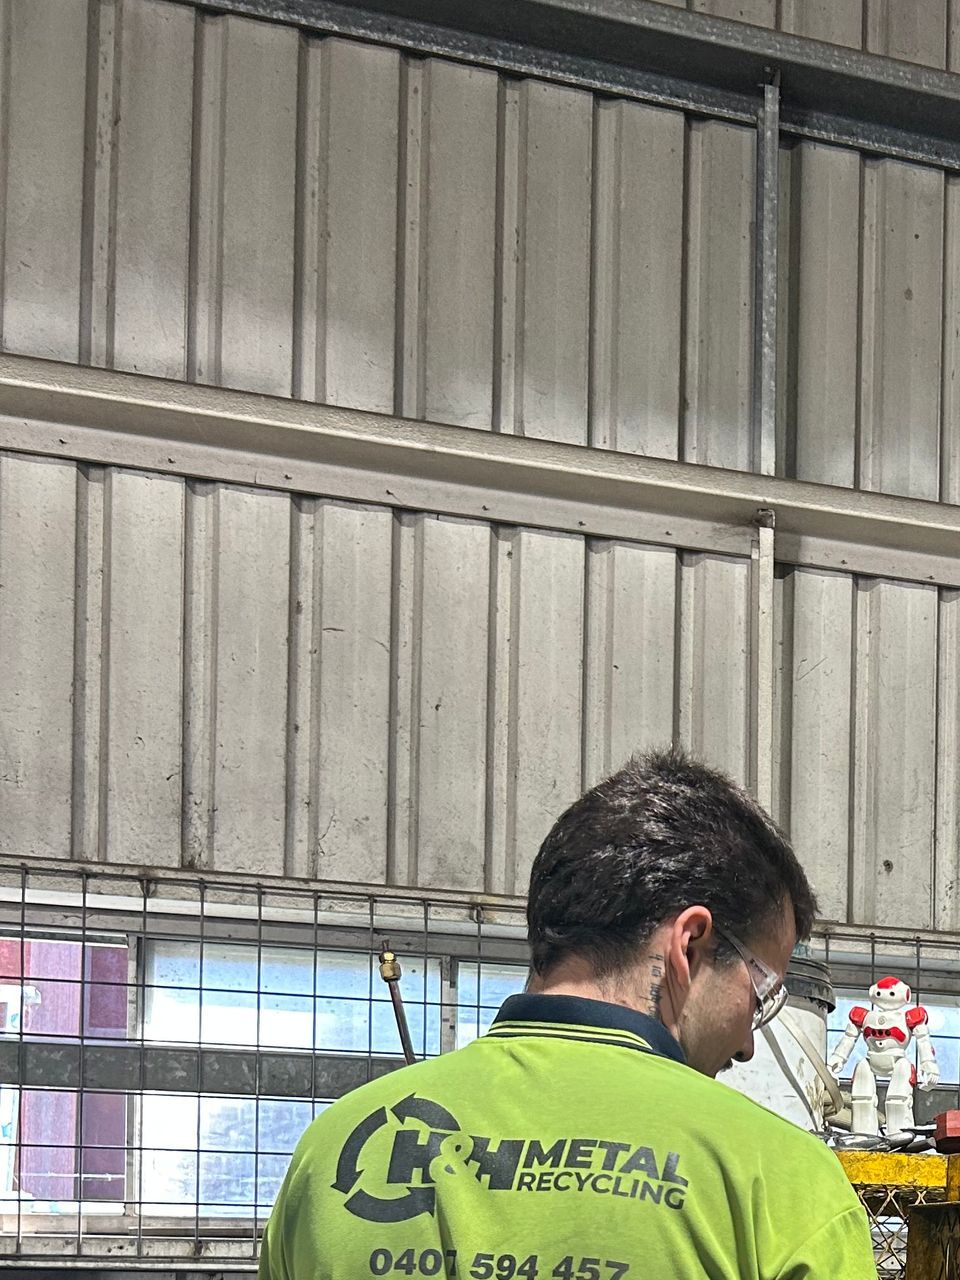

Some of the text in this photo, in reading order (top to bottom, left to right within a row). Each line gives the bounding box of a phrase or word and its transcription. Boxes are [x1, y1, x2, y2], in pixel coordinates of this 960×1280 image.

[387, 1130, 689, 1190] H&H METAL
[516, 1171, 687, 1210] RECYCLING
